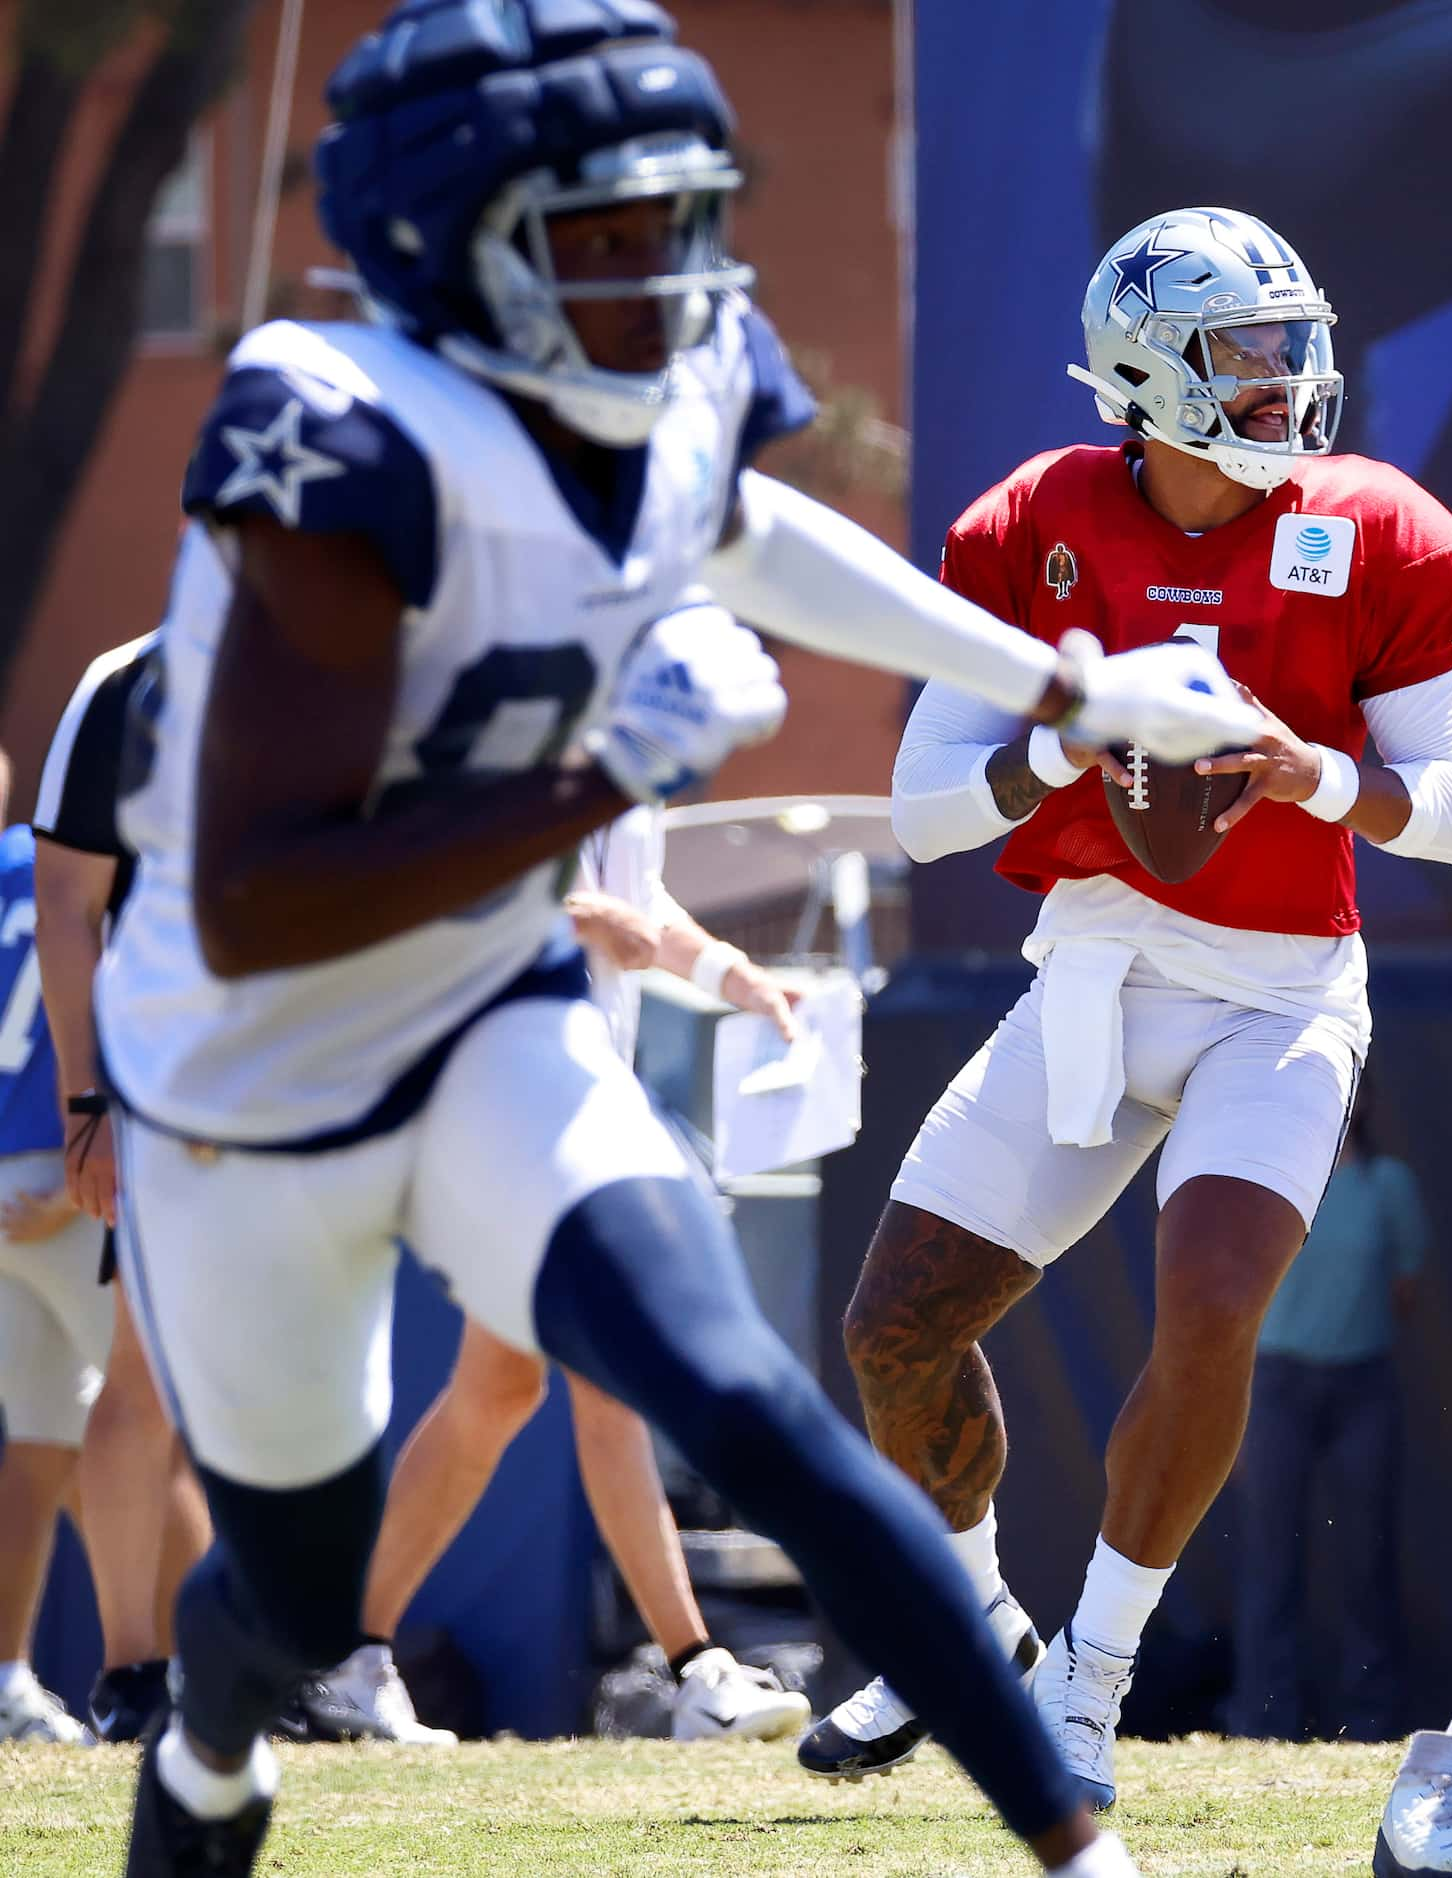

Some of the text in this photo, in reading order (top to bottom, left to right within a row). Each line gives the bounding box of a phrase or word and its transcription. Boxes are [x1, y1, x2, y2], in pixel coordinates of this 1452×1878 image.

[1269, 289, 1305, 299] COWB
[1288, 566, 1332, 585] AT&T
[1147, 586, 1223, 604] COWBOYS
